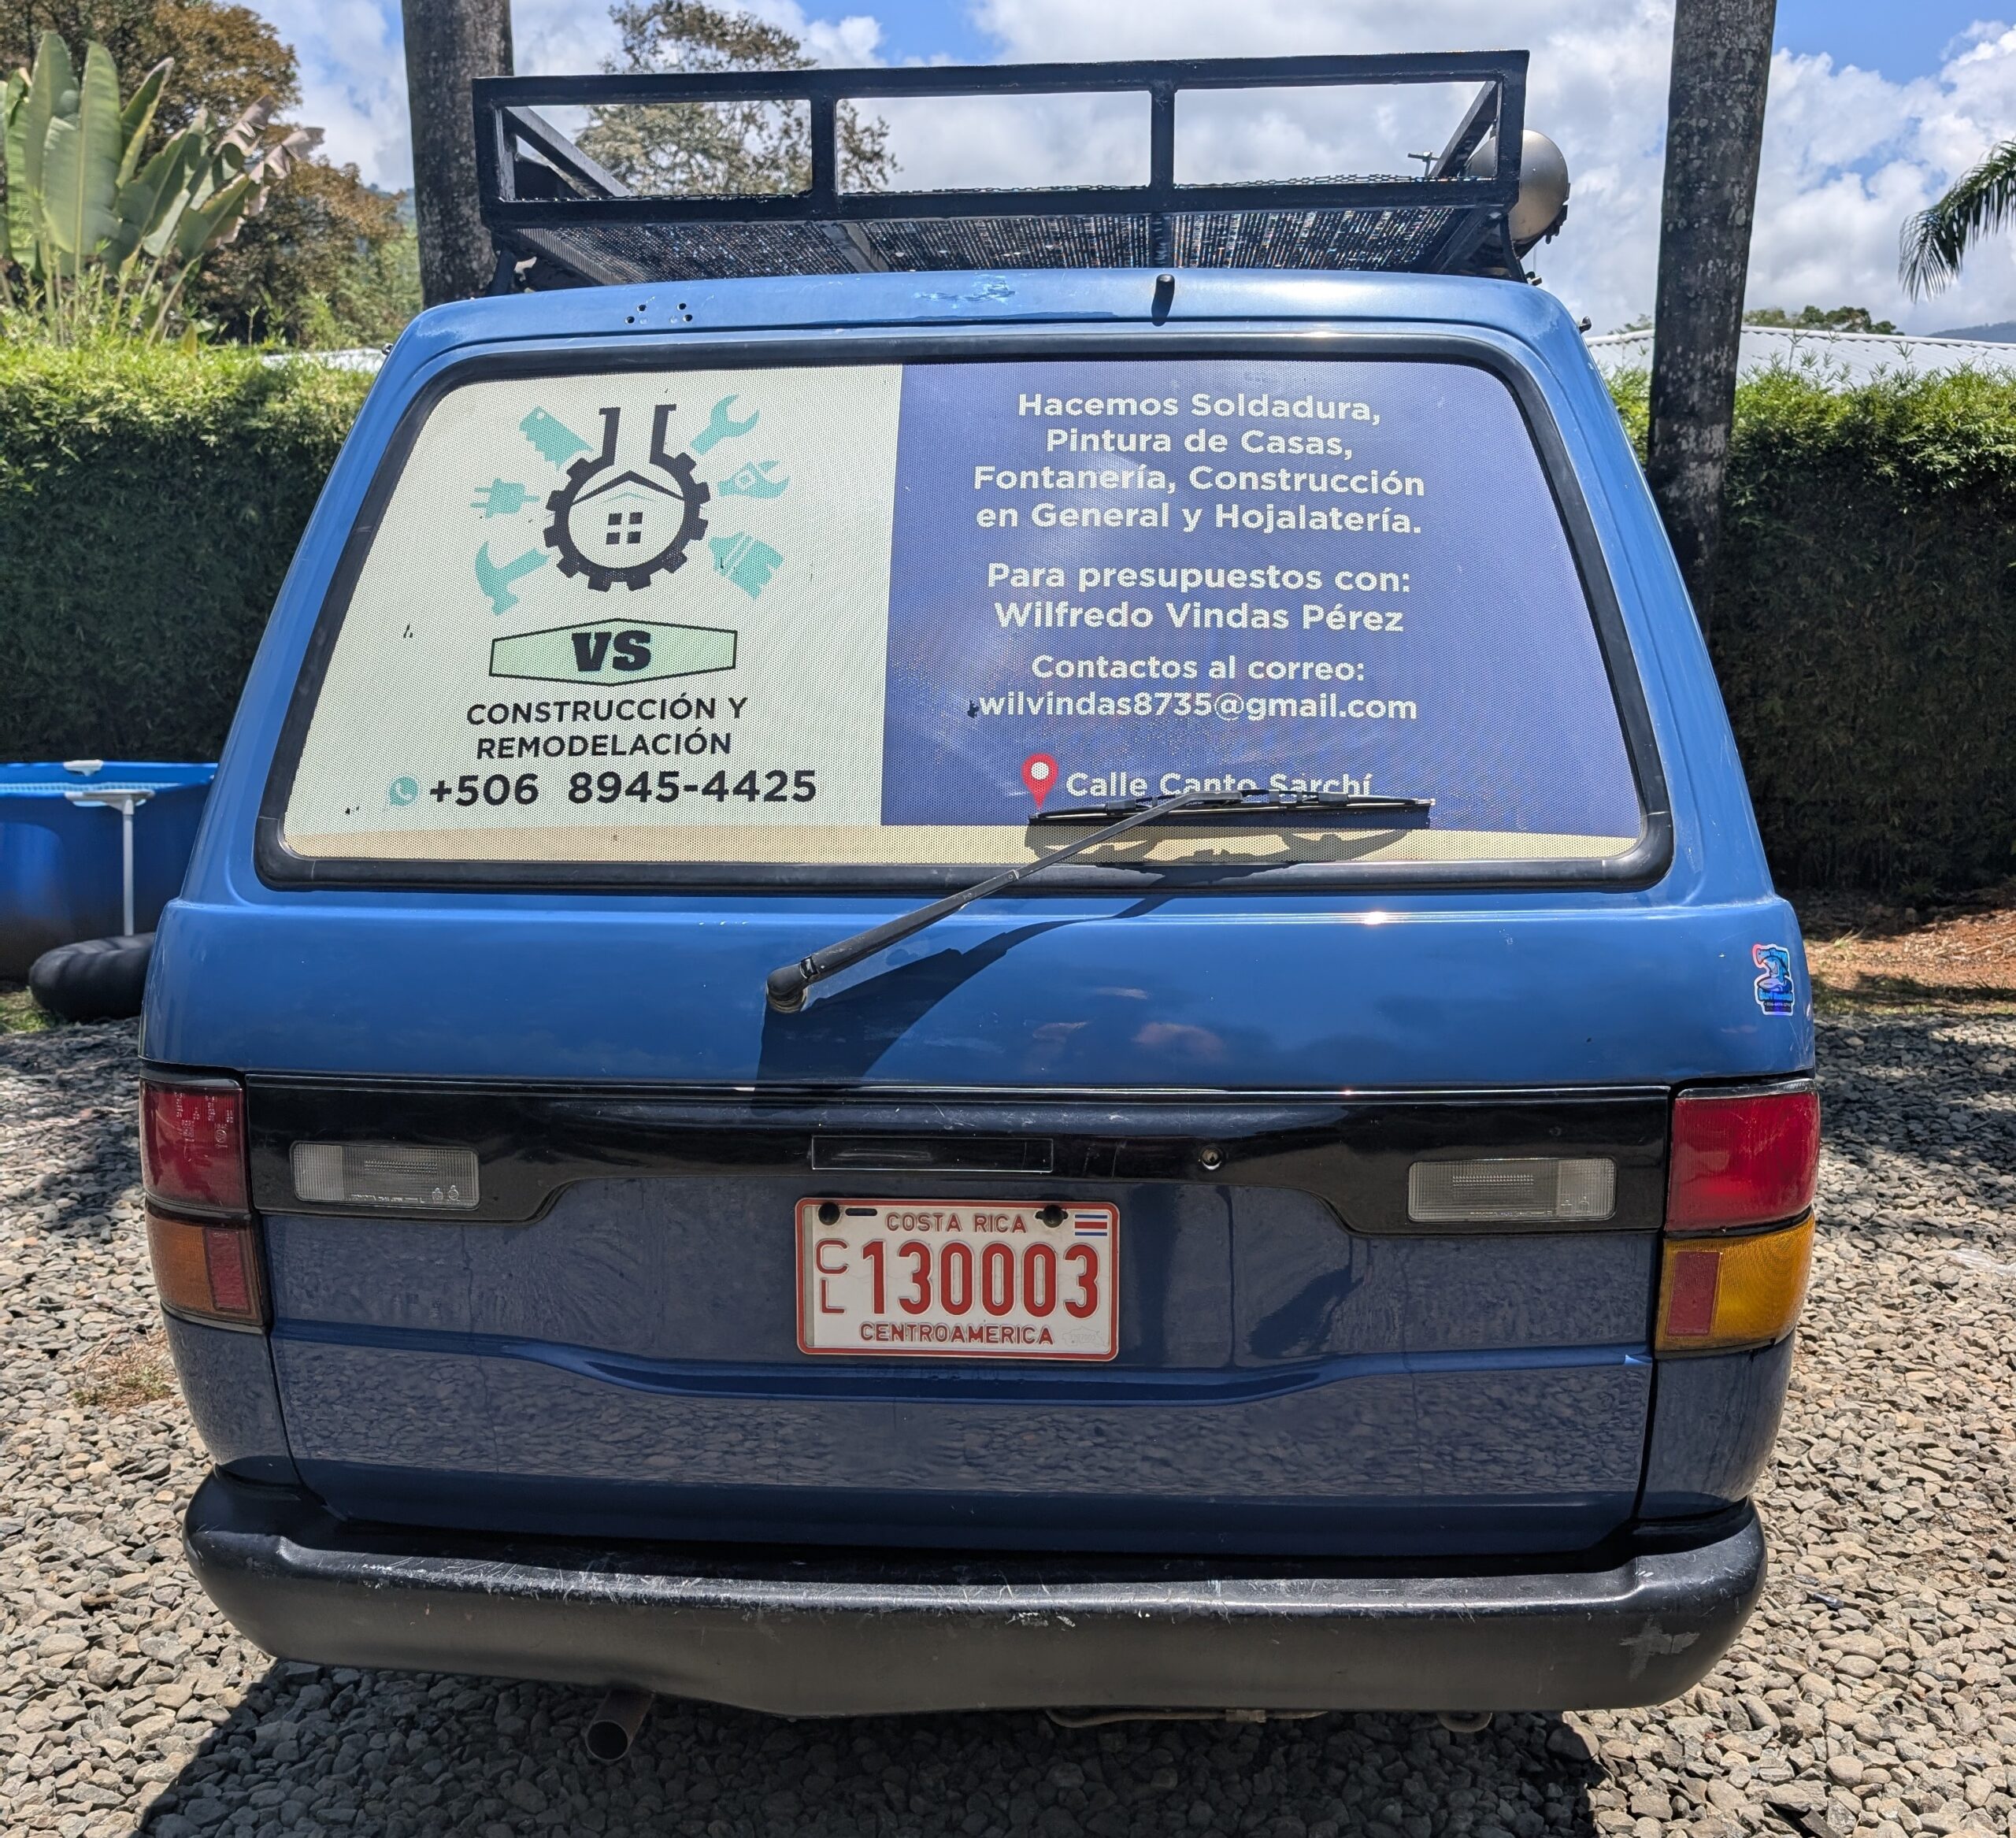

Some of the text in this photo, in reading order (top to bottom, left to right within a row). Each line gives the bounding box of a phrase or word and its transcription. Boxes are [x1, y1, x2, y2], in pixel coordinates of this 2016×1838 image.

[1018, 394, 1380, 426] Hacemos Soldadura,
[1046, 428, 1352, 459] Pintura de Casas,
[973, 465, 1425, 497] Fontanería, Construcción
[976, 503, 1421, 534] en General y Hojalatería.
[988, 564, 1410, 593] Para presupuestos con:
[995, 602, 1403, 632] Wilfredo Vindas Pérez
[572, 631, 652, 672] VS
[1032, 655, 1365, 681] Contactos al correo:
[466, 693, 748, 725] CONSTRUCCIÓN Y
[979, 691, 1418, 721] wilvindas8735@gmail.com
[476, 728, 732, 759] REMODELACIÓN
[430, 769, 817, 806] +506 8945-4425
[1065, 772, 1147, 797] Calle
[1269, 773, 1373, 797] Sarchí
[885, 1211, 1028, 1234] COSTA RICA
[862, 1240, 1099, 1318] 130003
[860, 1321, 1055, 1345] CENTROAMERICA
